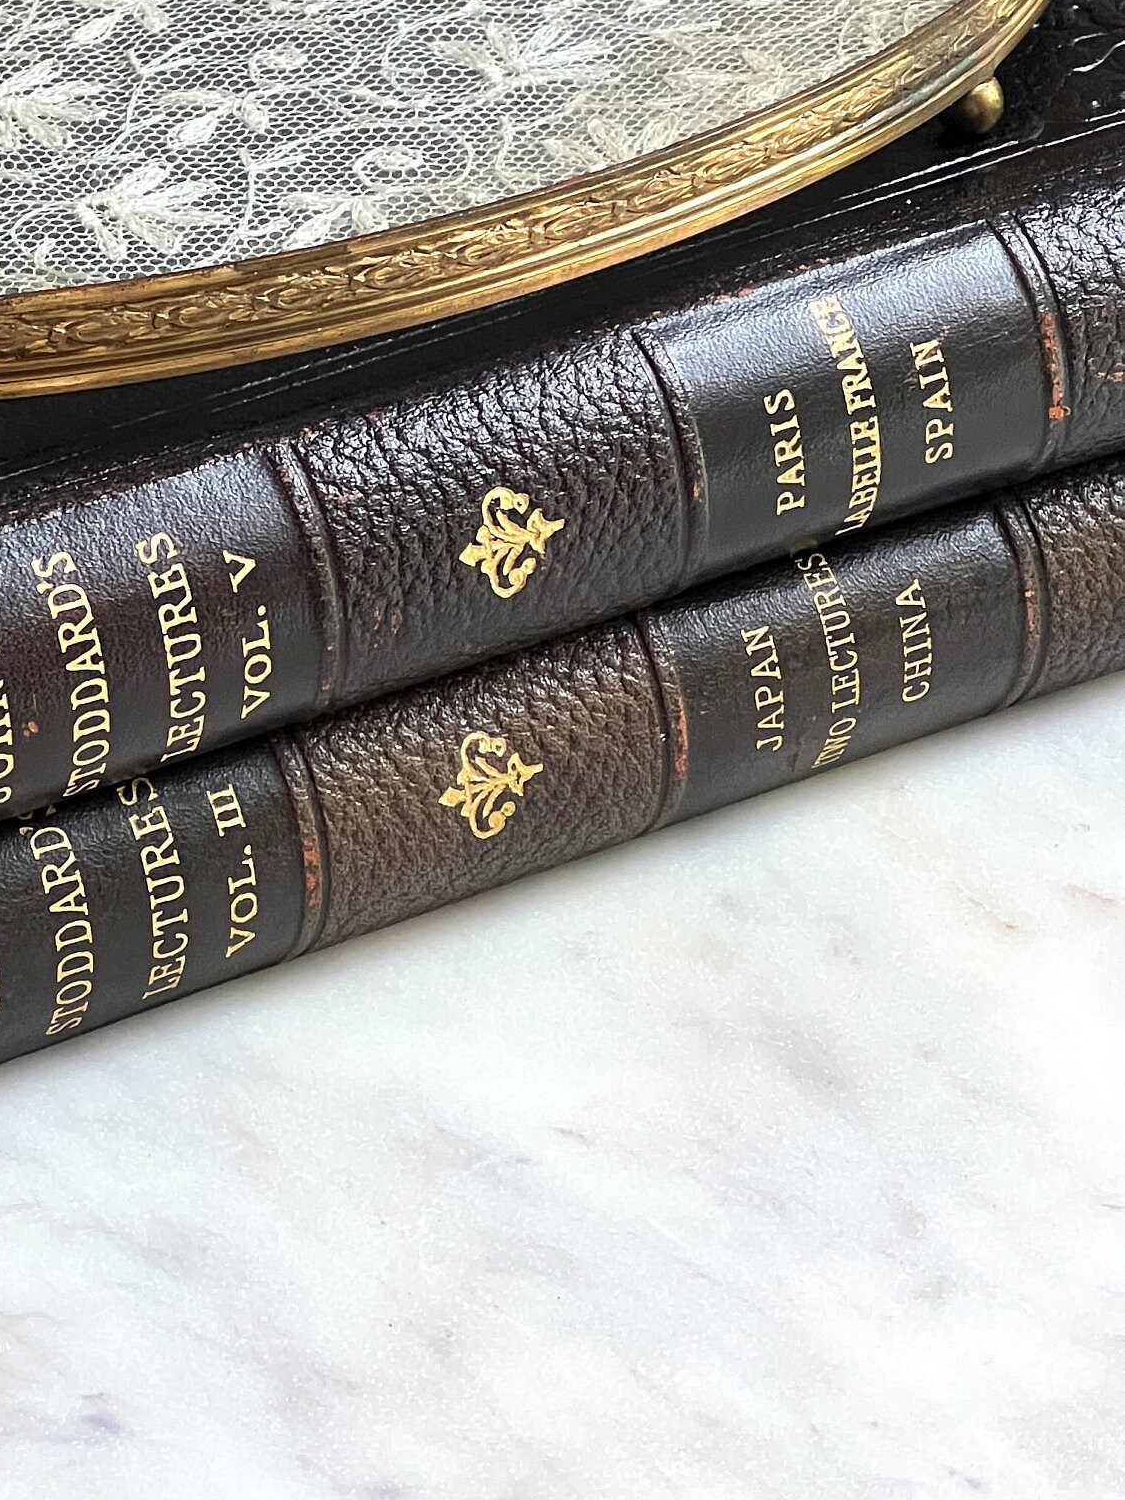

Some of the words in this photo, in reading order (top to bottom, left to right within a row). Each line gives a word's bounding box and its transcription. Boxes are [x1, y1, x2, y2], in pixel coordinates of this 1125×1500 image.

[764, 389, 806, 515] PARIS
[910, 339, 953, 464] SPAIN
[223, 550, 257, 593] V
[31, 550, 111, 798] STODDARD'S
[135, 531, 207, 764] LECTURES
[242, 604, 272, 720] VOL.
[741, 626, 784, 752] JAPAN
[896, 579, 933, 703] CHINA
[207, 783, 247, 837] III
[18, 804, 93, 1037] STODDARD'
[118, 776, 186, 1000] LECTURES
[225, 845, 258, 958] VOL.
